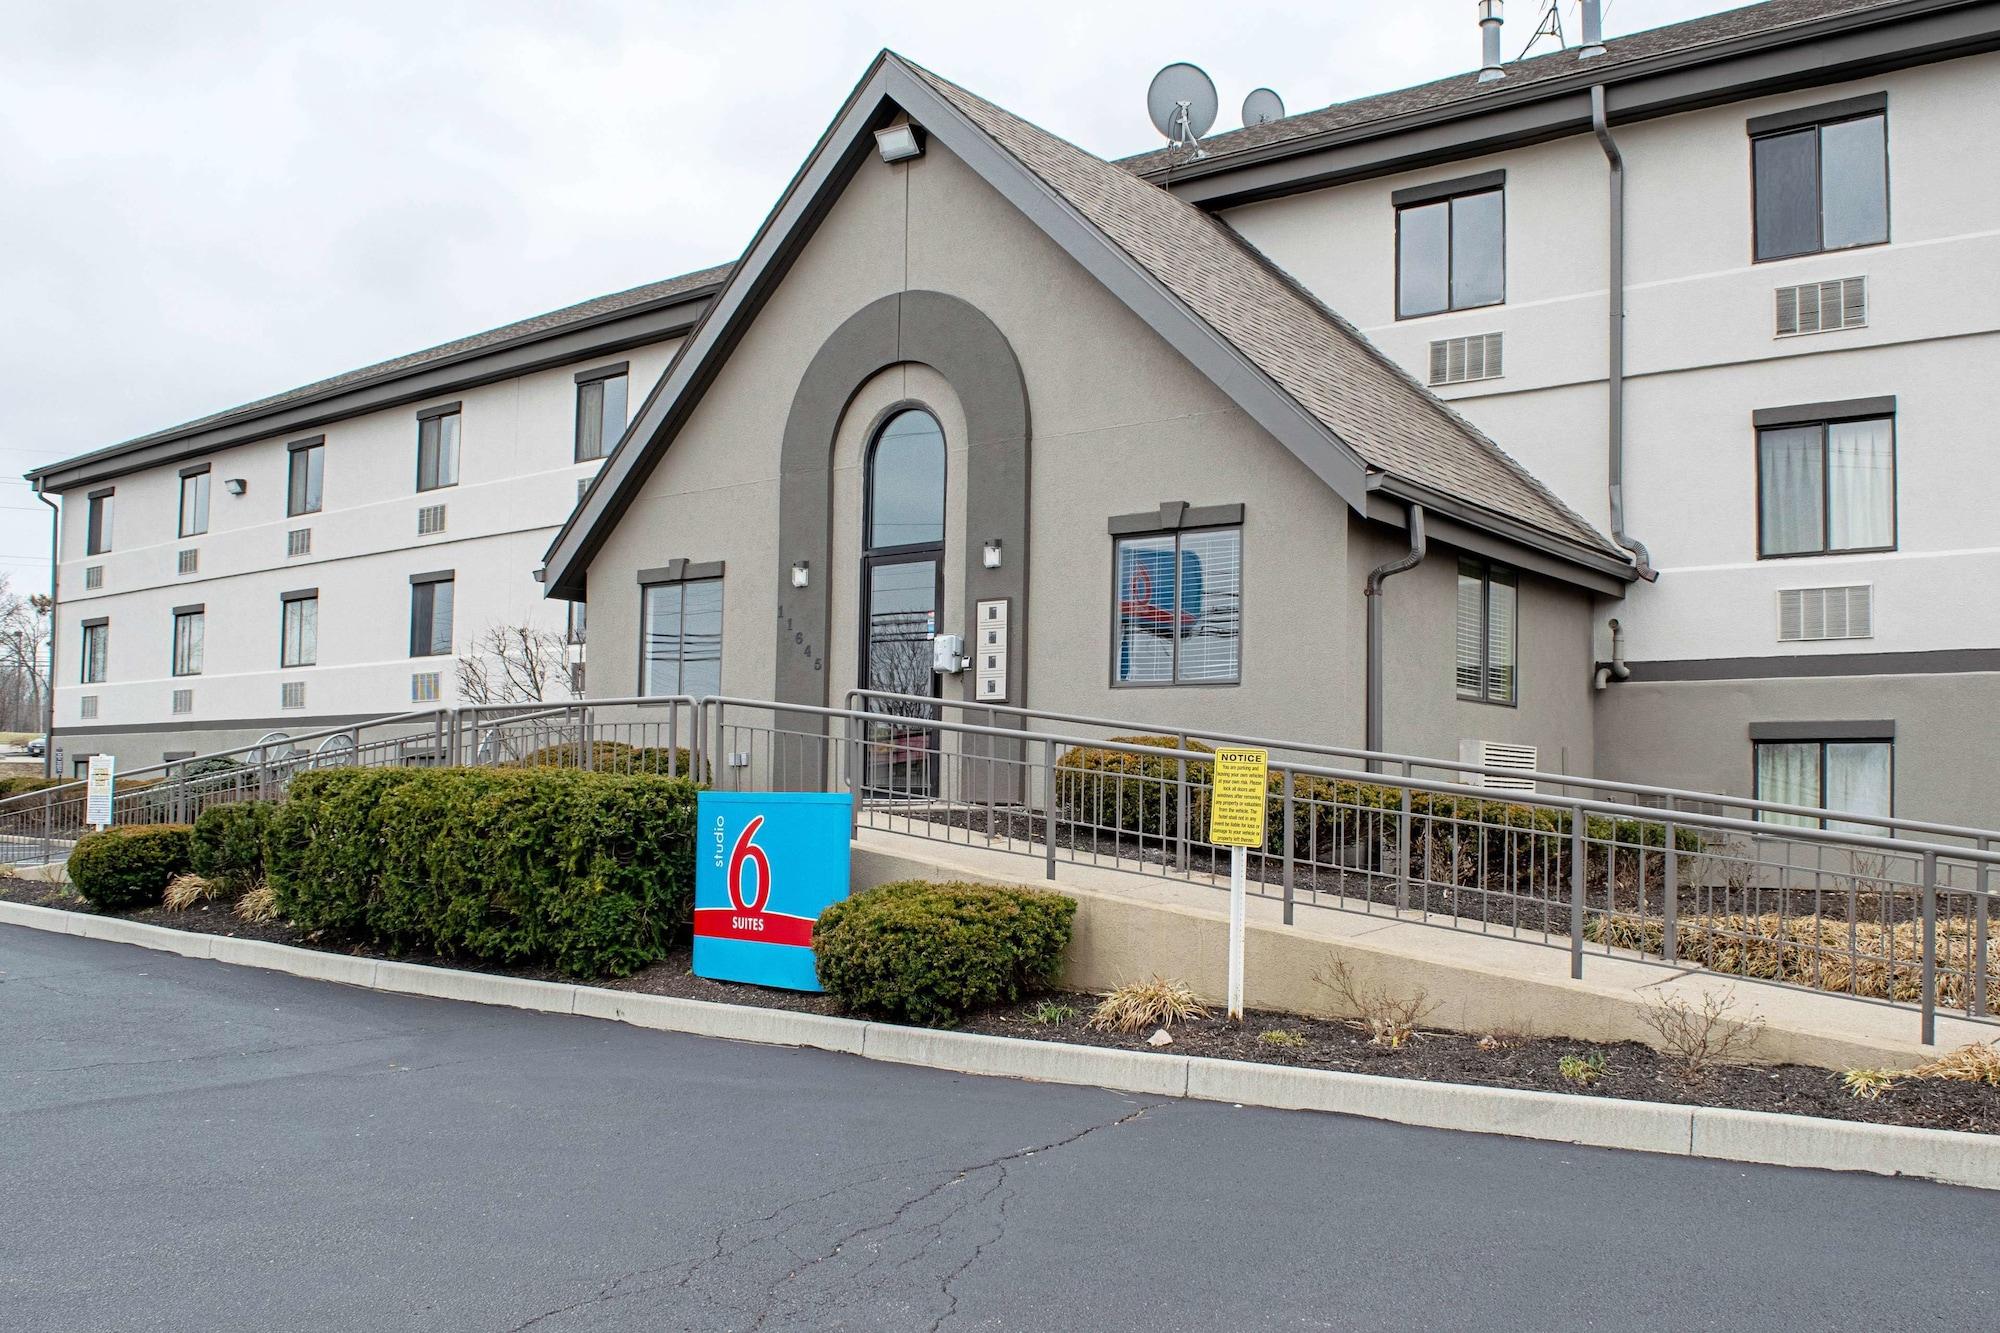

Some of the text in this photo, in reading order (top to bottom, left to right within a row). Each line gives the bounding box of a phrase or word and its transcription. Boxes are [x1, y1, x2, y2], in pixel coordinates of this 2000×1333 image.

[778, 605, 822, 671] 11645
[1221, 753, 1262, 763] NOTICE
[713, 814, 772, 912] studio 6
[731, 915, 765, 931] SUITES
